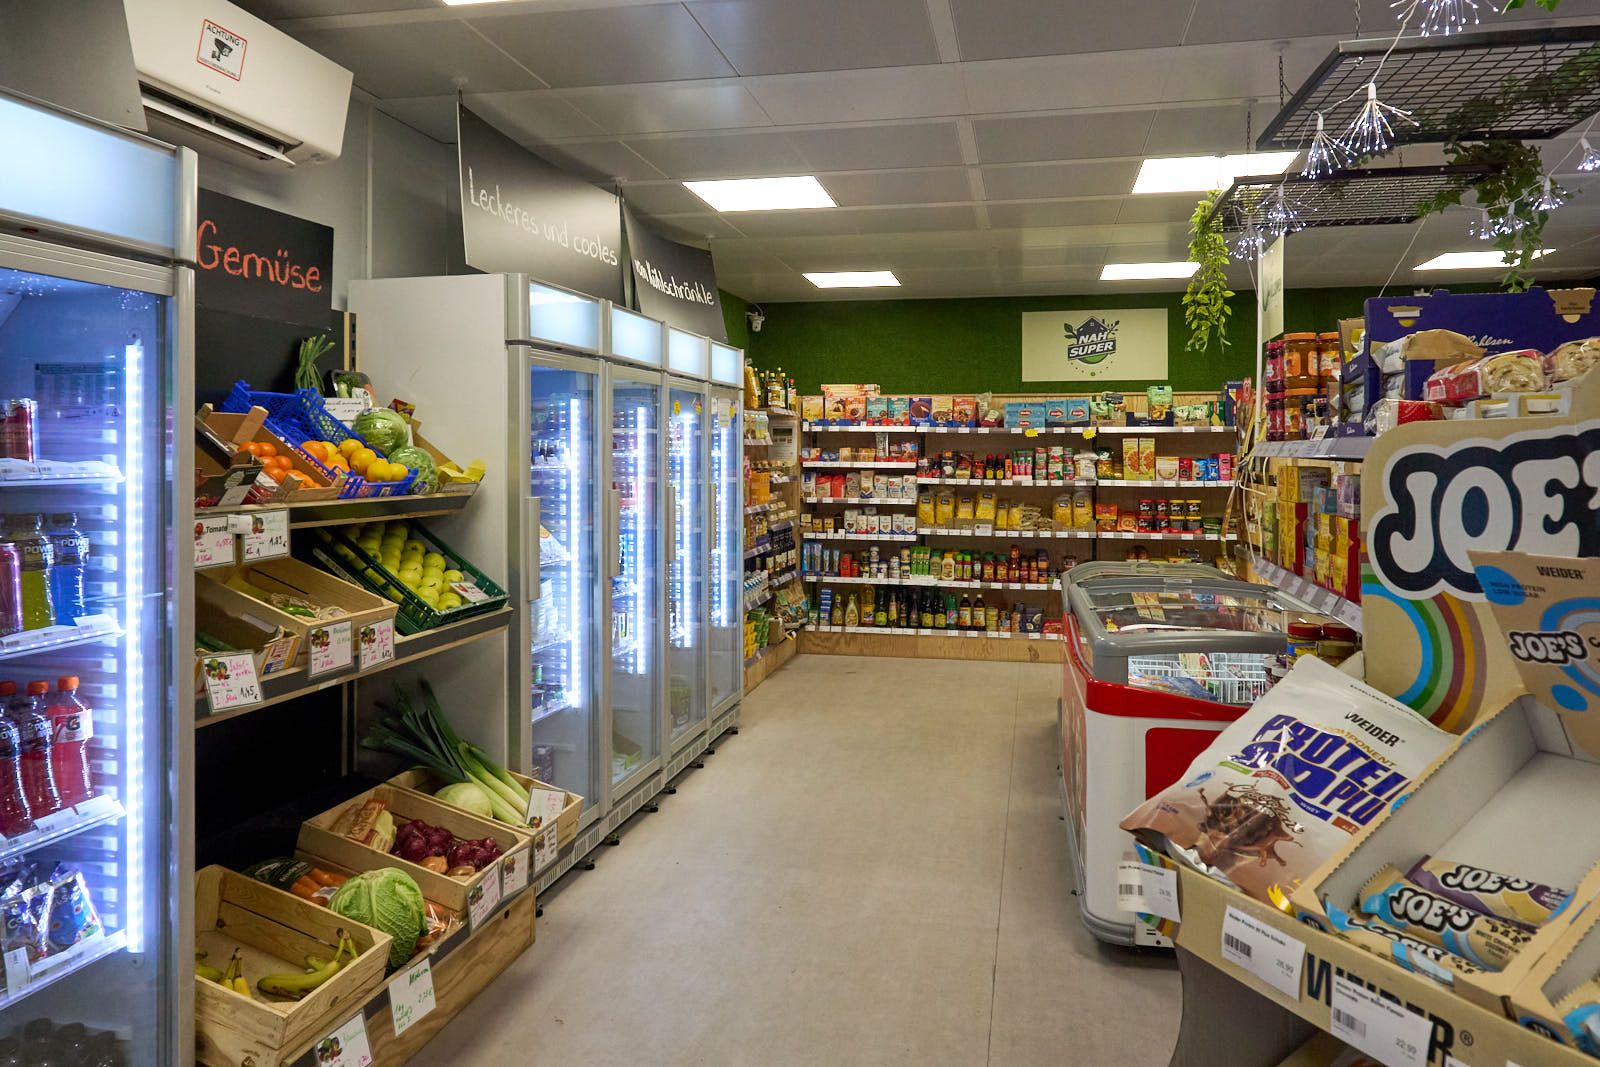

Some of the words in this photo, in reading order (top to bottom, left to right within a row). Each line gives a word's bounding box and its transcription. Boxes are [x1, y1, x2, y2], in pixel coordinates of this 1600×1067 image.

[206, 23, 240, 47] ACHTUNG
[468, 166, 539, 235] Leckeres
[543, 222, 569, 247] und
[573, 233, 619, 266] cooles
[196, 219, 322, 292] Gemüse
[1069, 341, 1114, 357] SUPER
[1078, 331, 1108, 345] NAH
[1536, 565, 1584, 580] WEIDER
[1510, 631, 1586, 664] JOE'S
[1344, 711, 1400, 747] WEIDER
[1320, 777, 1387, 826] PLU
[1391, 889, 1479, 933] JOE'S
